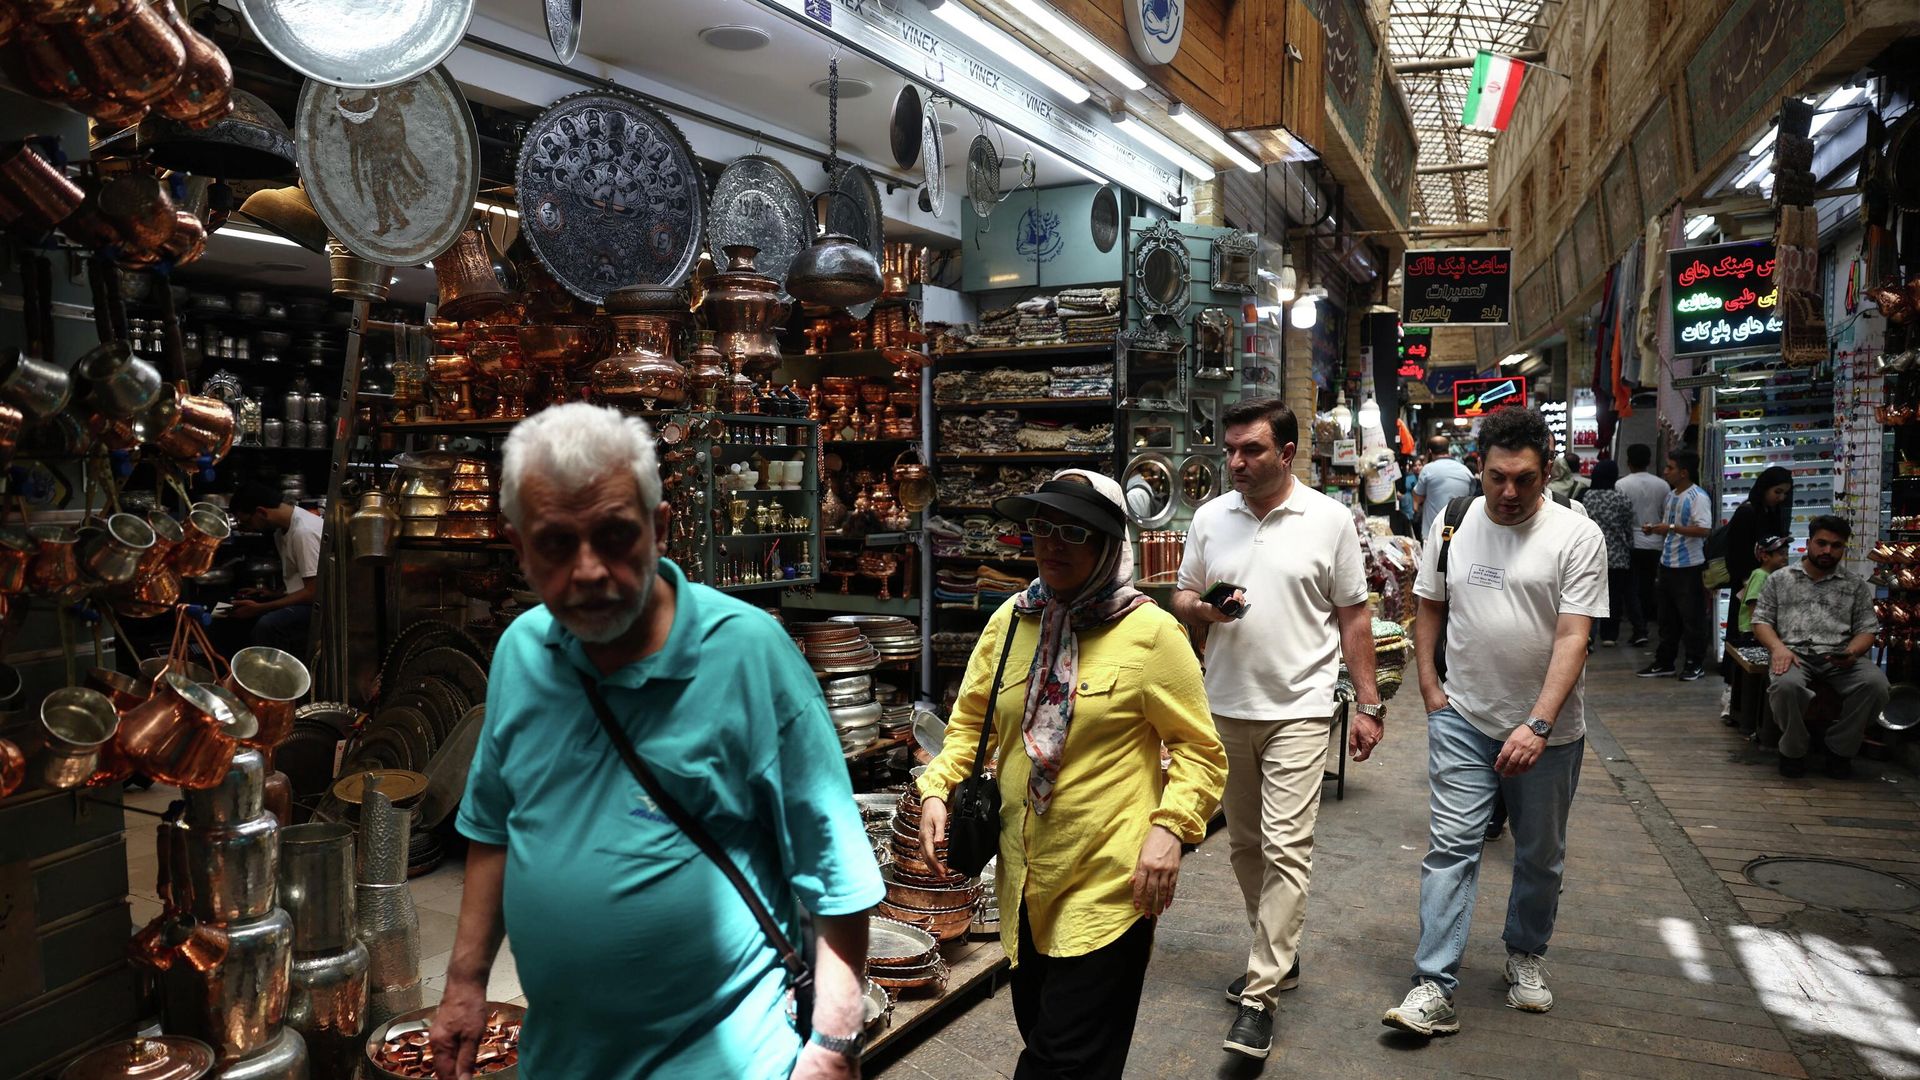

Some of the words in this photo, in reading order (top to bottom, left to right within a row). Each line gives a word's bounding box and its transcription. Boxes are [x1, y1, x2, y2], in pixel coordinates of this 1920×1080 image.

[902, 22, 939, 56] VINEX
[969, 60, 1000, 91] VINEX
[1026, 94, 1053, 121] VINEX
[1408, 256, 1435, 276] تاک
[1438, 256, 1466, 280] تیک
[1468, 255, 1507, 276] ساعت
[1679, 259, 1710, 287] های
[1713, 256, 1754, 278] عینک
[1425, 283, 1487, 302] تعمیرات
[1724, 287, 1756, 312] طبی
[1409, 304, 1451, 323] باطری
[1480, 304, 1502, 322] بند
[1732, 315, 1765, 341] های
